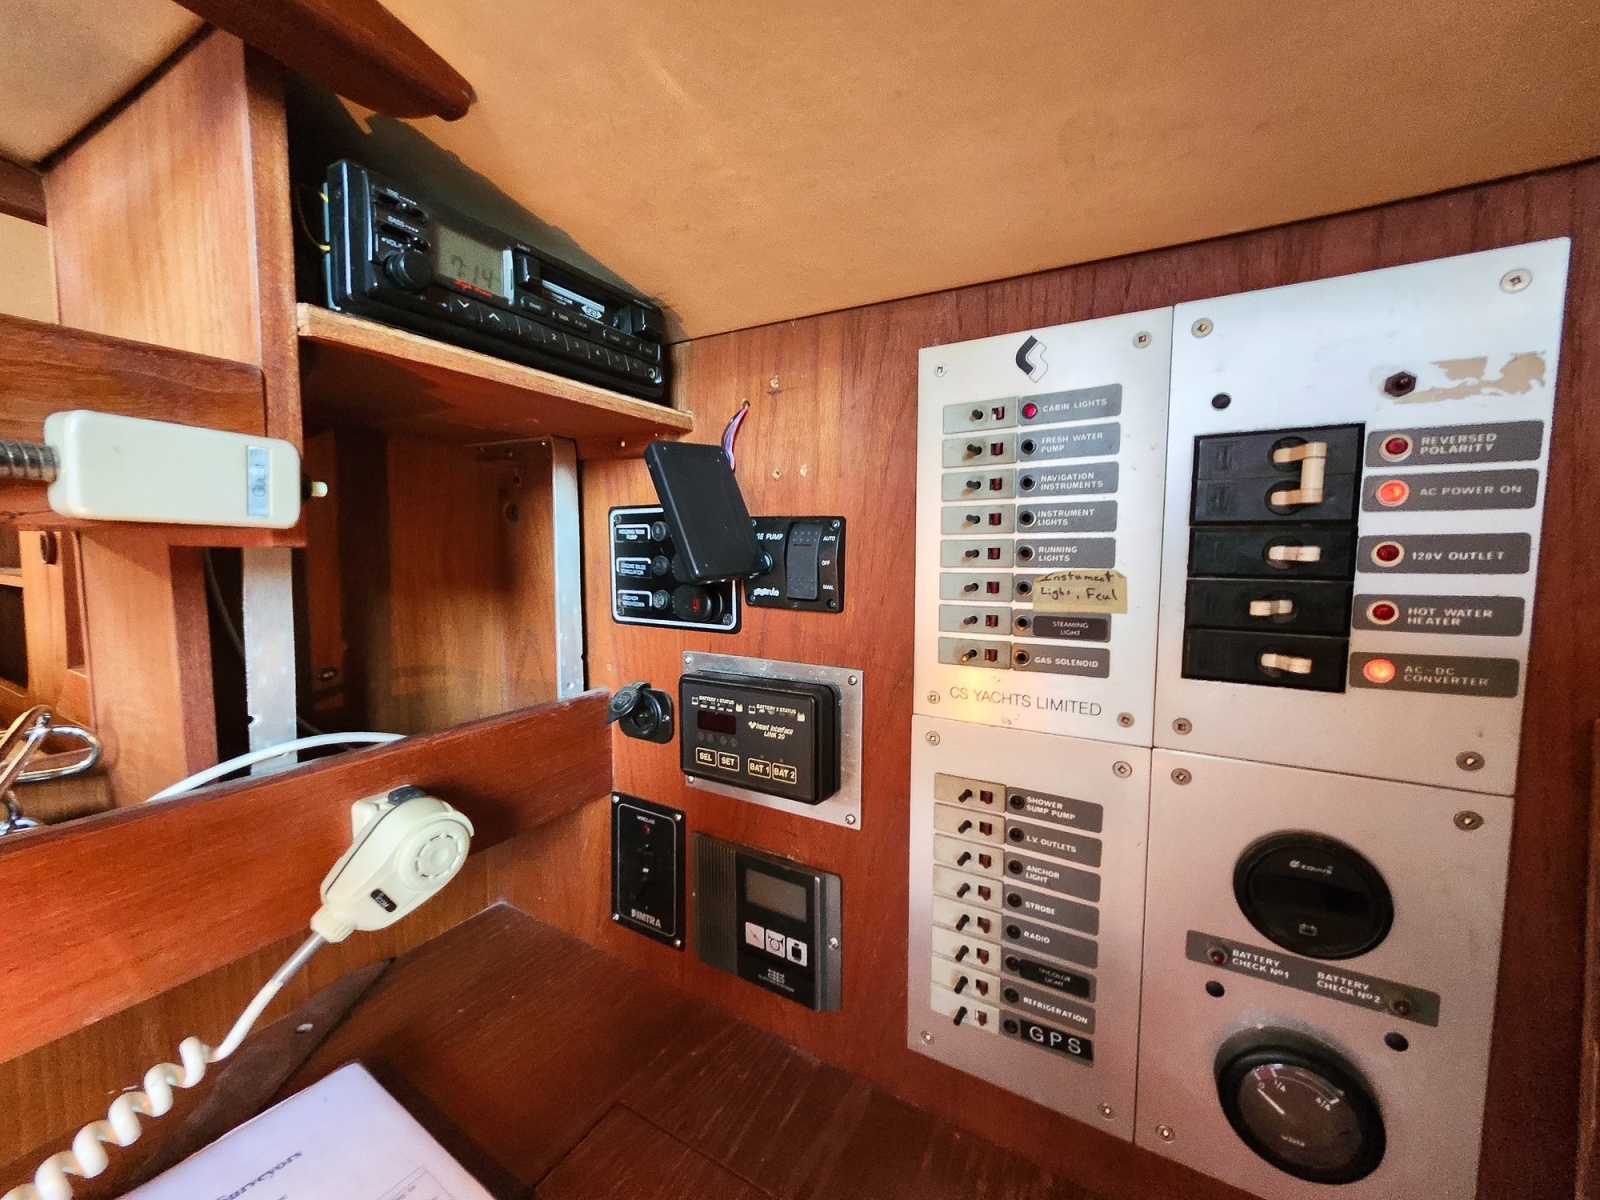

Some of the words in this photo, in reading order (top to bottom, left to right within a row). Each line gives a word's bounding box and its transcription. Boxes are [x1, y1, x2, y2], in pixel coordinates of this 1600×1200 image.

[1042, 402, 1070, 413] CABIN
[1074, 398, 1107, 410] LIGHTS
[1042, 435, 1068, 444] FRESH
[1072, 432, 1104, 442] WATER
[1420, 433, 1497, 446] REVERSED
[1041, 444, 1064, 453] PUMP
[1420, 444, 1494, 455] POLARITY
[1040, 472, 1094, 482] NAVIGATION
[1040, 480, 1103, 490] INSTRUMENTS
[1420, 488, 1436, 496] AC
[1442, 486, 1494, 496] POWER
[1500, 485, 1522, 494] ON
[1038, 508, 1095, 518] INSTRUMENT
[1038, 518, 1068, 526] LIGHTS
[1038, 546, 1078, 554] RUNNING
[1038, 554, 1070, 562] LIGHTS
[1412, 552, 1442, 561] 120V
[1448, 552, 1504, 560] OUTLET
[1408, 607, 1436, 617] HOT
[1444, 608, 1493, 618] WATER
[1407, 617, 1460, 626] HEATER
[1034, 656, 1052, 664] GAS
[1055, 658, 1098, 668] SOLENOID
[1404, 674, 1490, 686] CONVERTER
[950, 686, 968, 700] CS
[974, 690, 1032, 708] YACHTS
[1036, 696, 1102, 716] LIMITED
[699, 752, 712, 761] SEL
[721, 755, 735, 765] SET
[750, 762, 763, 772] BAT
[774, 768, 788, 777] BAT
[1026, 796, 1063, 810] SHOWER
[1026, 804, 1049, 814] SUMP
[1051, 810, 1076, 820] PUMP
[1041, 838, 1077, 853] OUTLETS
[1026, 865, 1060, 879] ANCHOR
[1026, 872, 1048, 884] LIGHT
[1025, 902, 1056, 915] STROBE
[1024, 931, 1050, 944] RADIO
[1232, 949, 1280, 968] BATTERY
[1232, 957, 1267, 973] CHECK
[1317, 971, 1370, 991] BATTERY
[1316, 980, 1354, 998] CHECK
[1023, 996, 1088, 1024] REFRIGERATION
[1029, 1026, 1081, 1054] GPS
